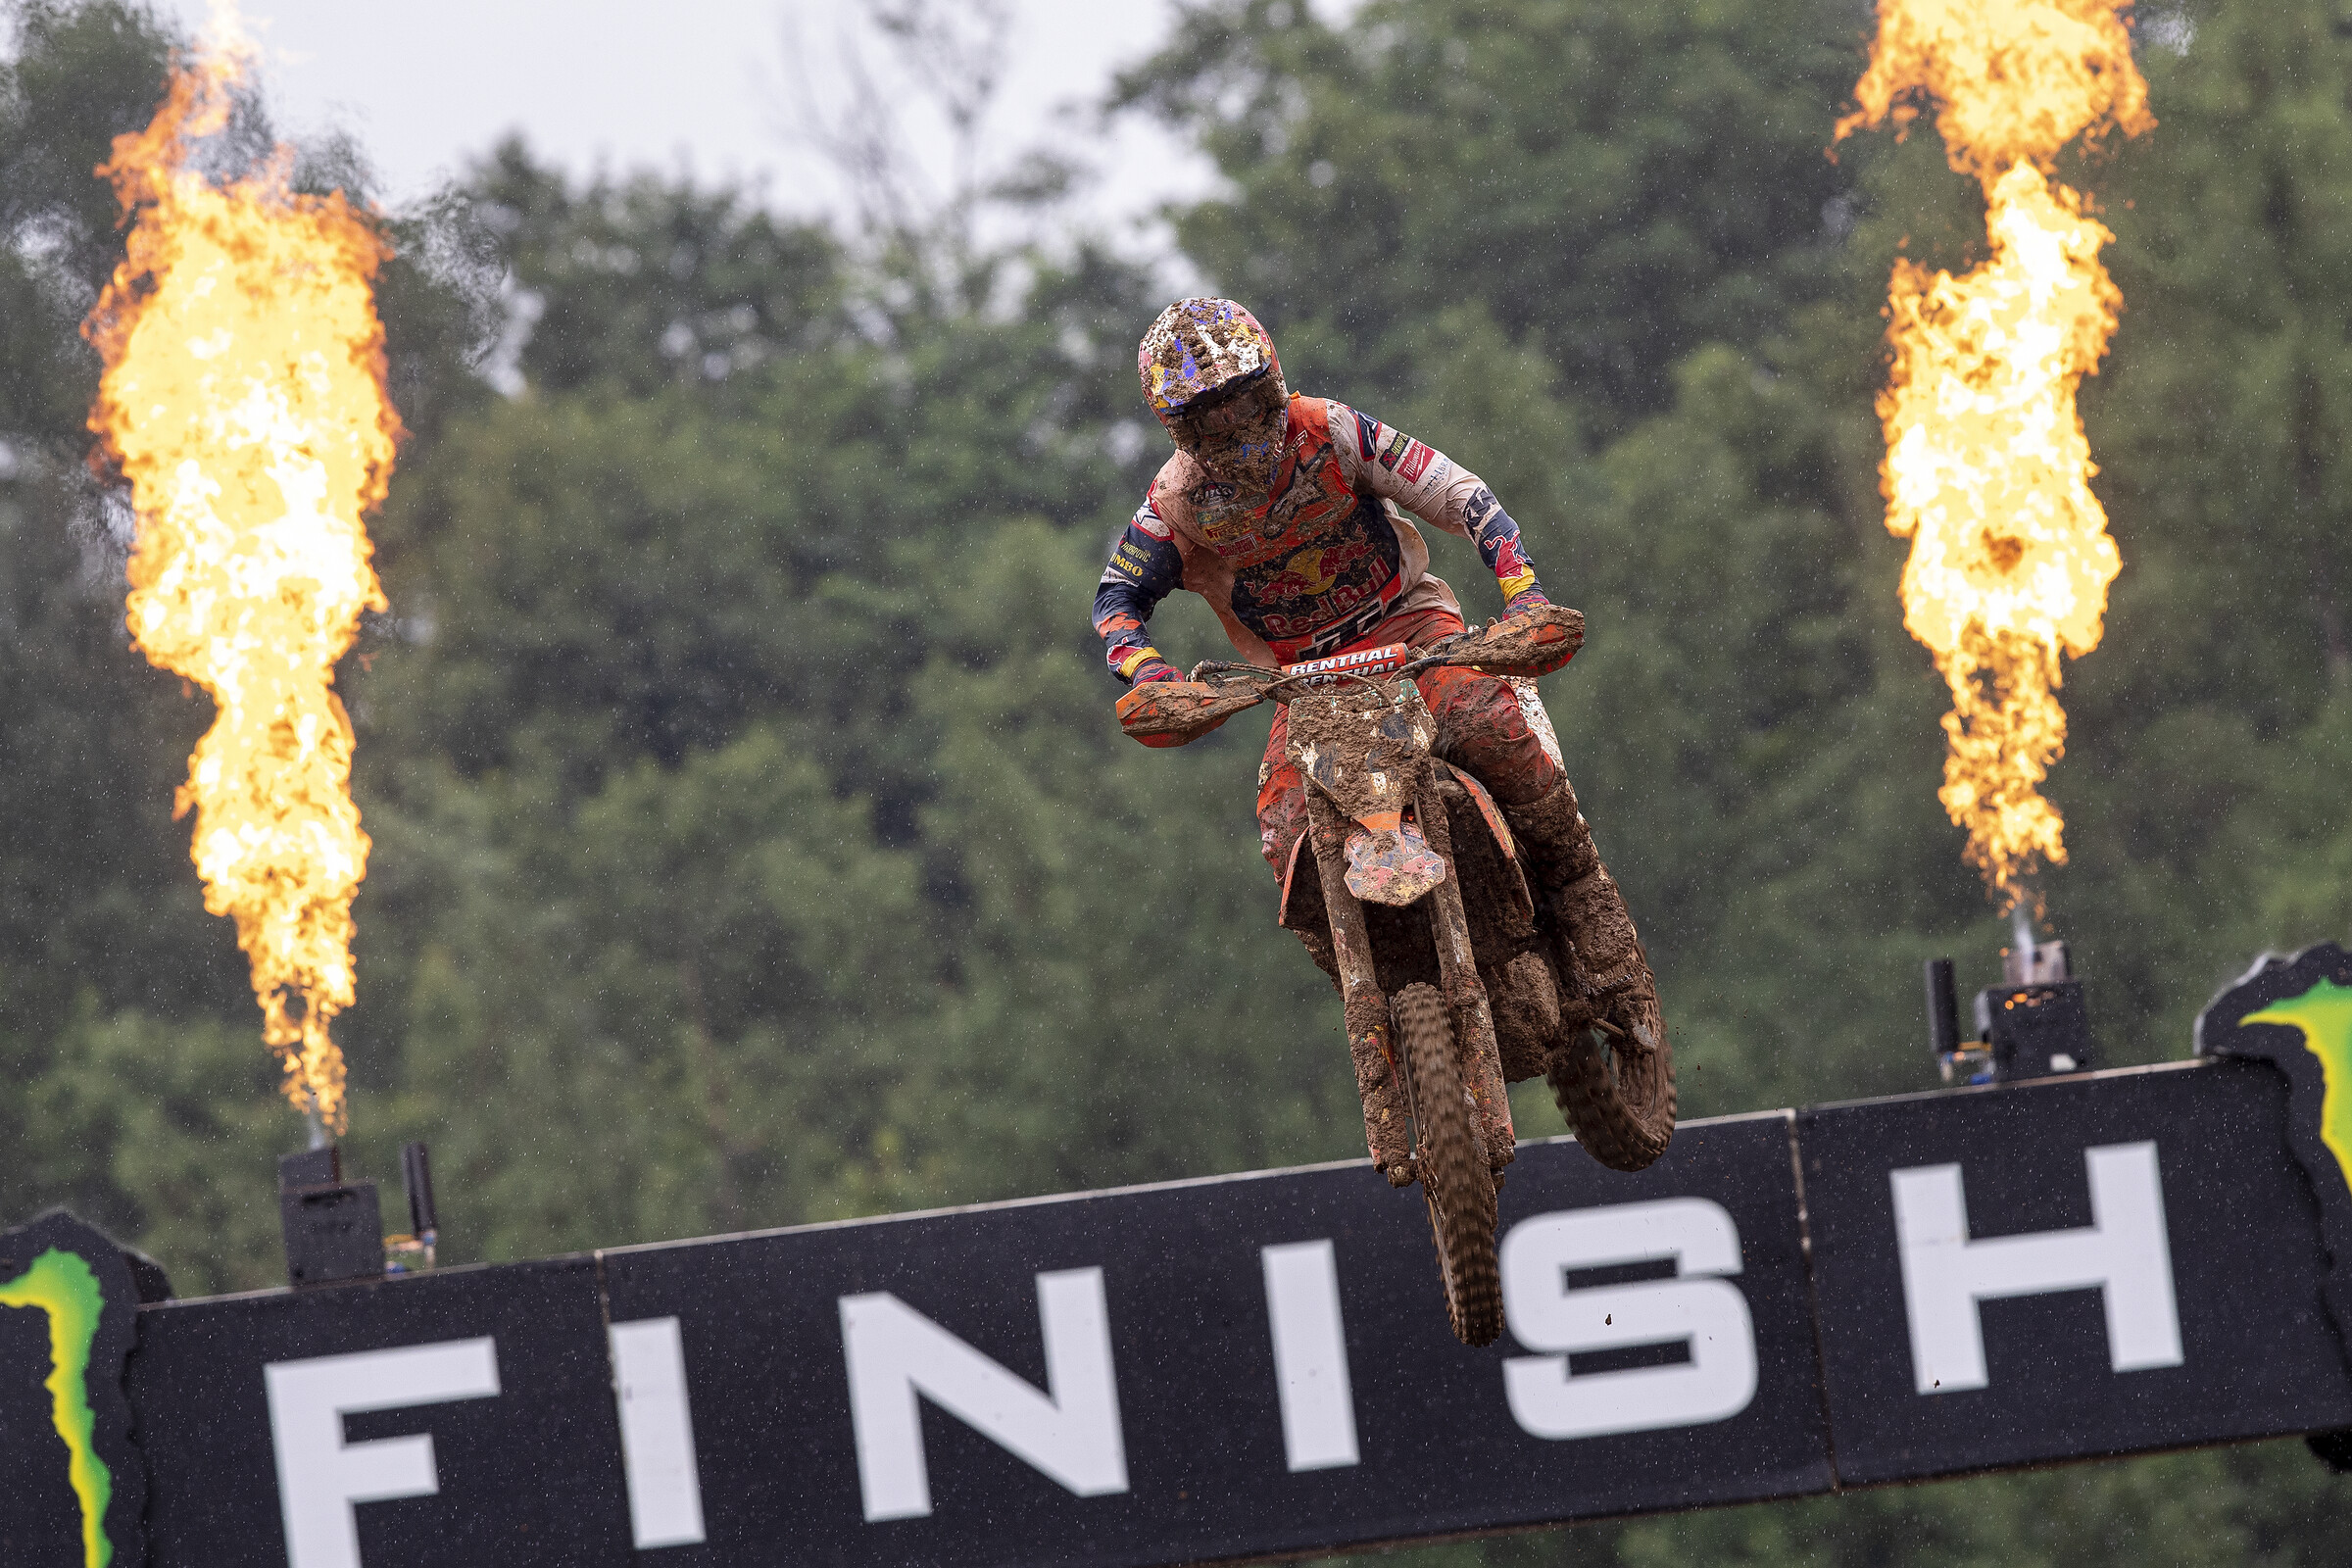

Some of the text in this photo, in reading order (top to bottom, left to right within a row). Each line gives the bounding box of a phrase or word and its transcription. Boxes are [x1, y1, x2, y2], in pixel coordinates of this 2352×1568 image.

[1261, 556, 1392, 637] Red Bull
[1290, 647, 1397, 676] RENTHAL
[1302, 662, 1397, 686] ENHAL
[264, 1140, 2184, 1568] FINISH
